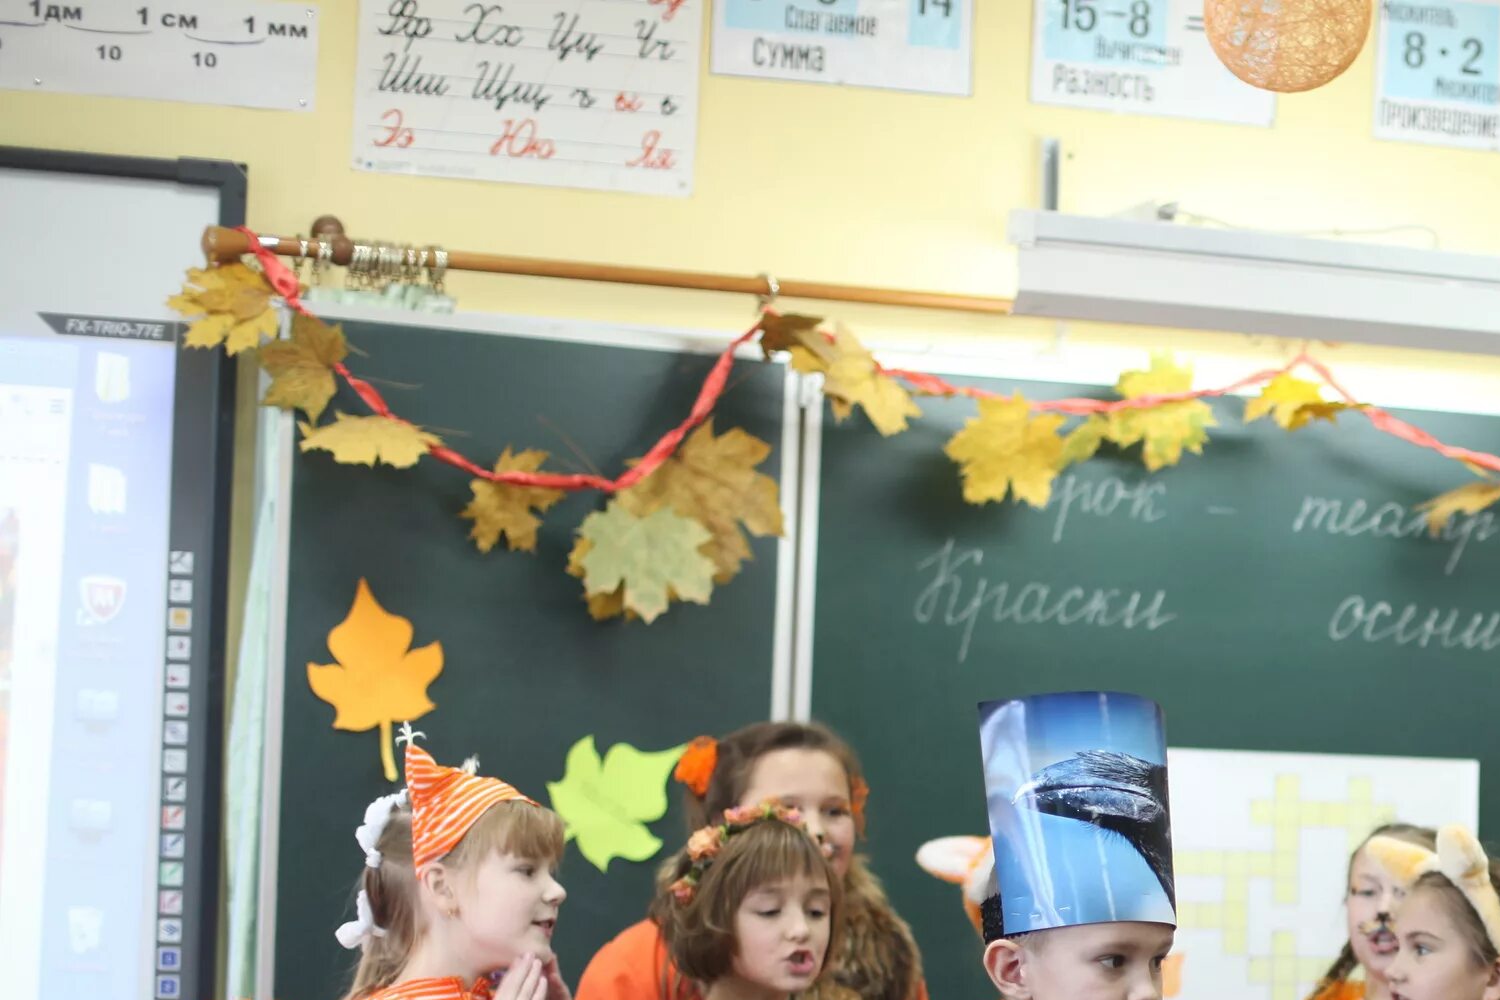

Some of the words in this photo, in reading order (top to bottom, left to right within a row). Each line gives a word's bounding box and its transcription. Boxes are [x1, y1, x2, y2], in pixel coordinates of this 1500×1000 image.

[136, 7, 149, 25] 1
[161, 13, 199, 29] см
[243, 16, 256, 33] 1
[267, 22, 308, 39] мм
[96, 45, 123, 60] 10
[192, 52, 217, 68] 10
[753, 37, 826, 72] Сумма
[1053, 63, 1155, 102] Разность
[1380, 98, 1500, 137] Произведение
[1050, 474, 1167, 543] рок
[914, 537, 1178, 663] Краски
